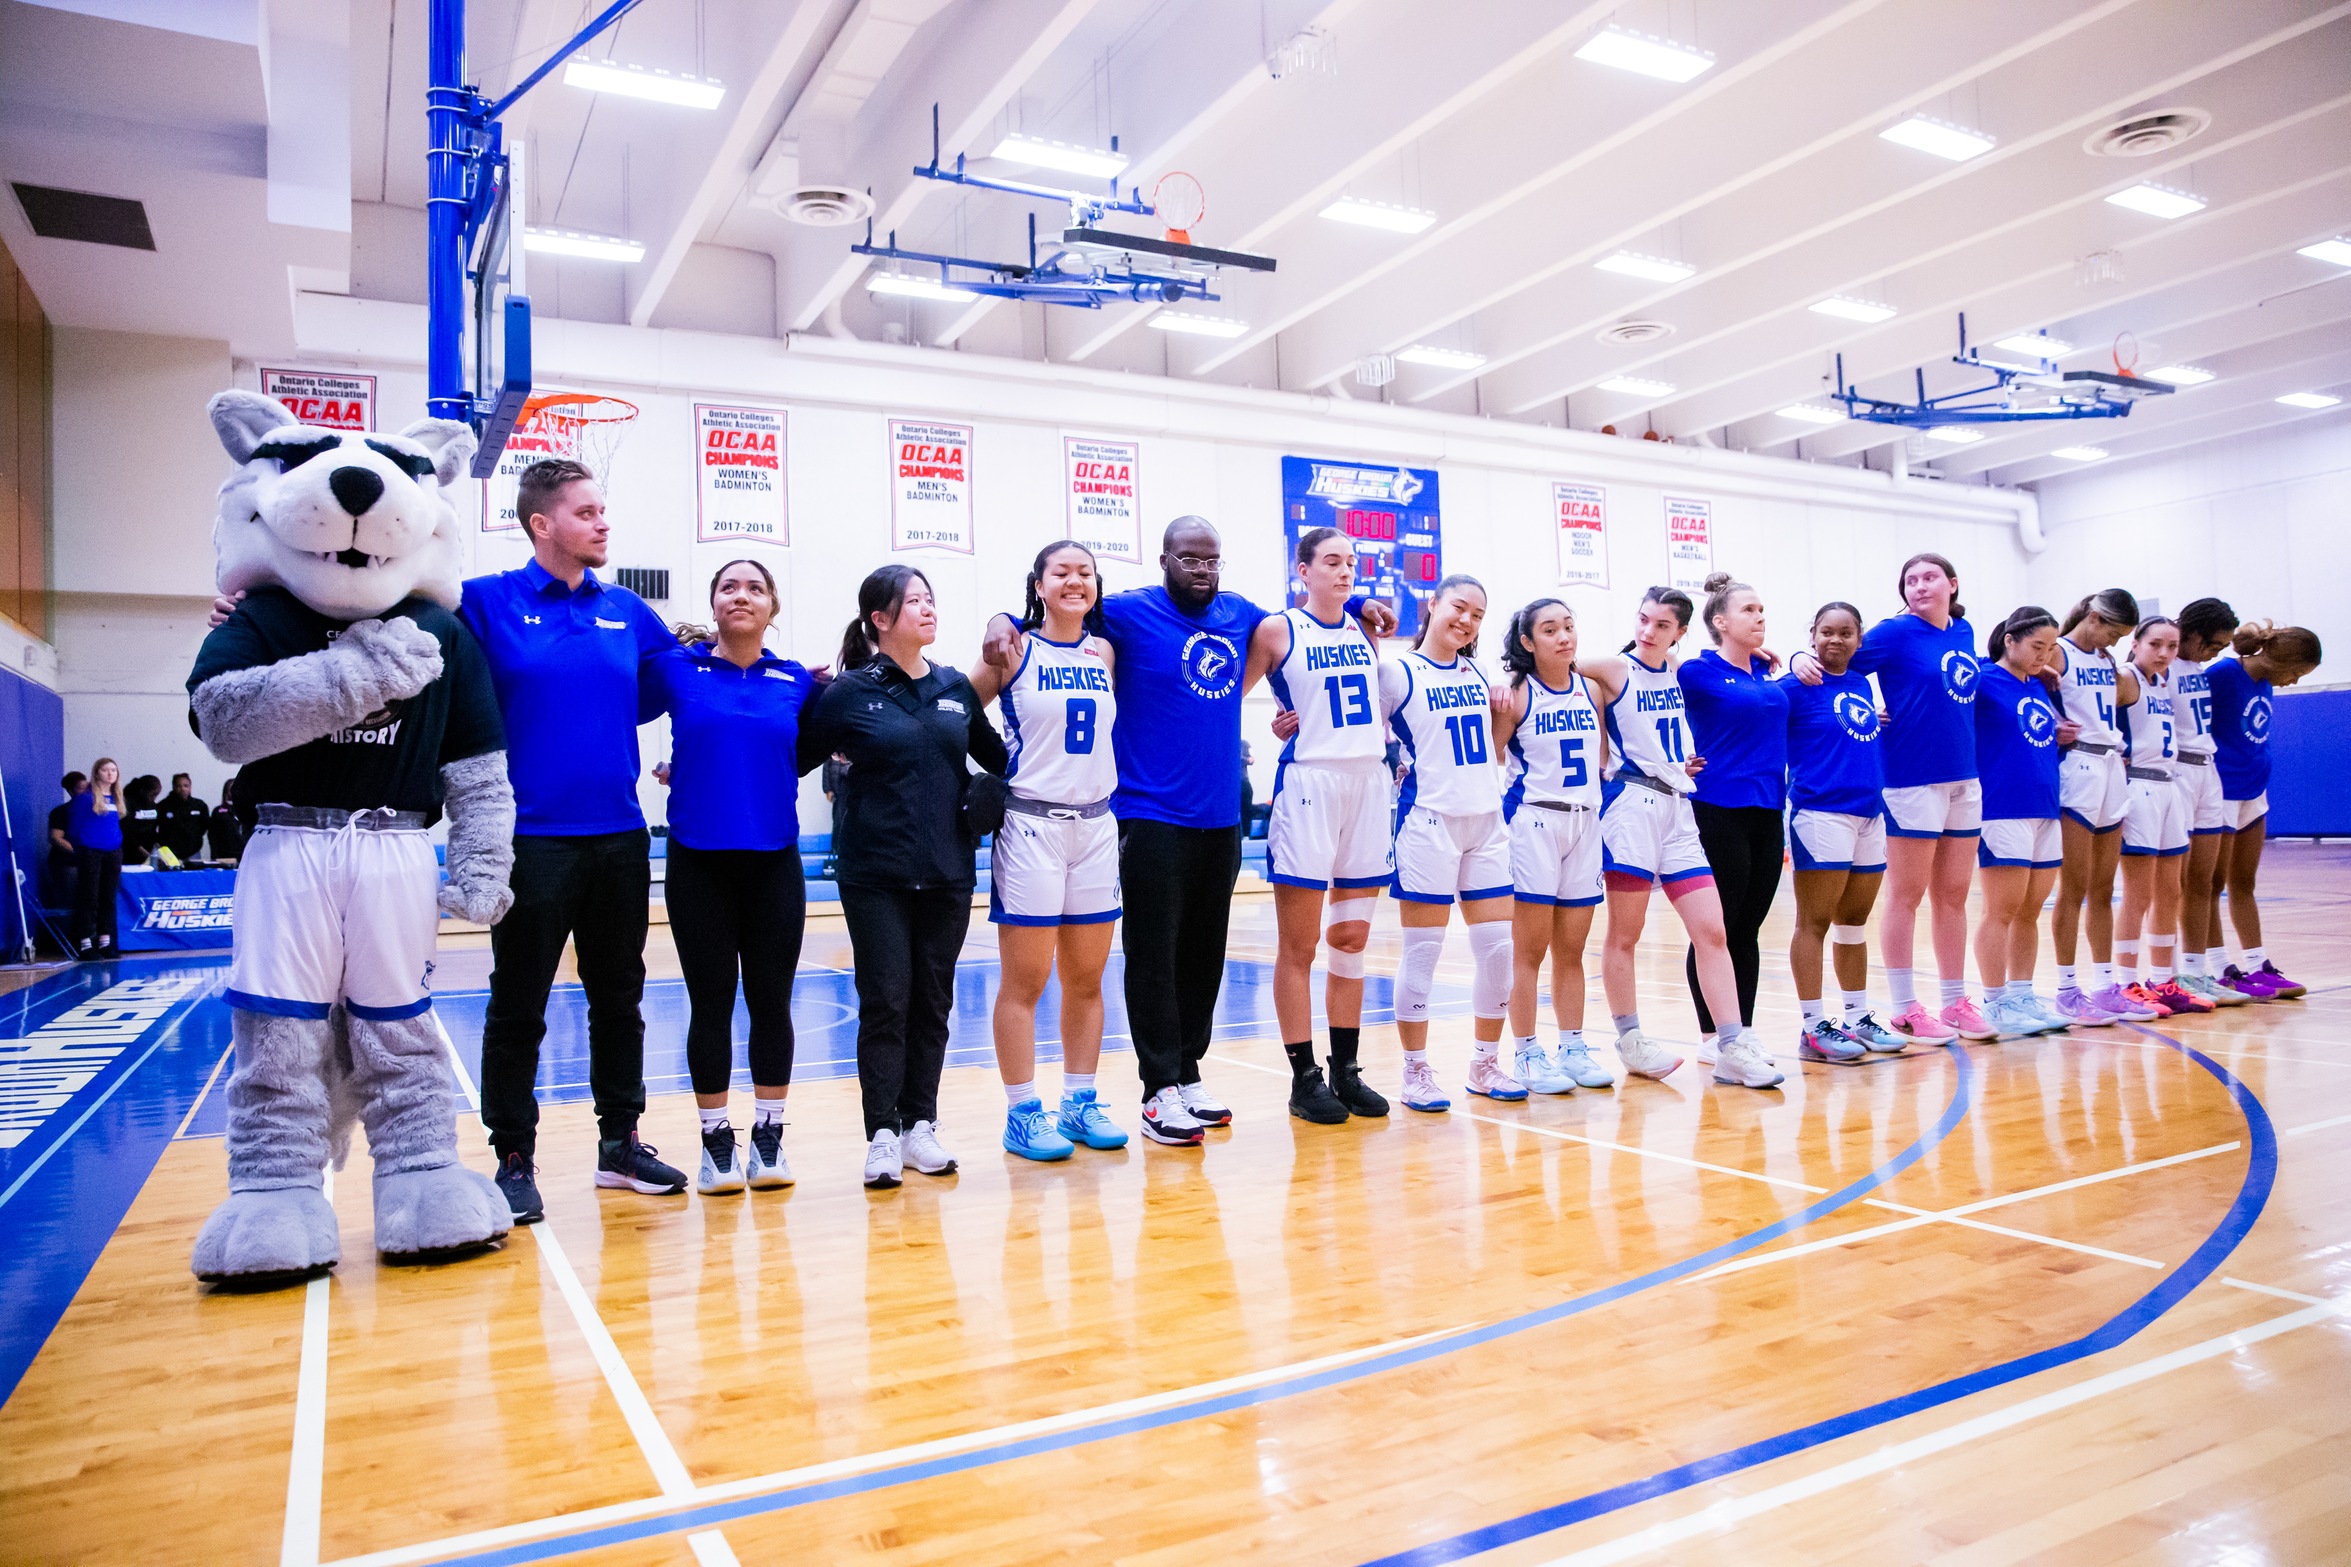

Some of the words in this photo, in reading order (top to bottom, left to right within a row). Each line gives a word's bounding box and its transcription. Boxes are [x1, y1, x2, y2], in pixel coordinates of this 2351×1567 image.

[271, 384, 309, 396] Athletic
[312, 387, 368, 399] Association
[279, 375, 316, 387] Ontario
[318, 379, 360, 390] Colleges
[702, 418, 732, 428] Athletic
[735, 420, 780, 431] Association
[708, 410, 738, 420] Ontario
[740, 412, 774, 422] Colleges
[896, 433, 923, 441] Athletic
[925, 435, 967, 446] Association
[901, 424, 928, 434] Ontario
[930, 427, 960, 437] Colleges
[708, 429, 776, 452] OCAA
[705, 451, 779, 470] CHAMPIONS
[901, 444, 962, 465] OCAA
[718, 468, 768, 481] WOMEN'S
[899, 464, 964, 482] CHAMPIONS
[1075, 462, 1129, 481] OCAA
[714, 479, 772, 491] BADMINTON
[917, 481, 948, 492] MEN'S
[1073, 480, 1133, 498] CHAMPIONS
[1314, 476, 1390, 498] HUSKIES
[906, 490, 958, 503] BADMINTON
[1082, 496, 1125, 508] WOMEN'S
[1077, 506, 1130, 517] BADMINTON
[1561, 501, 1600, 519] OCAA
[713, 520, 773, 533] 2017-2018
[1346, 509, 1395, 540] 10:00
[1671, 516, 1706, 531] OCAA
[906, 530, 959, 542] 2017-2018
[1421, 553, 1436, 581] 0
[1306, 643, 1372, 671] HUSKIES
[1037, 664, 1110, 693] HUSKIES
[2076, 667, 2116, 687] HUSKIE
[1190, 678, 1236, 700] HUSKIES
[1425, 684, 1487, 712] HUSKIES
[1324, 673, 1373, 729] 13
[2095, 692, 2114, 731] 4
[1064, 698, 1097, 755] 8
[1535, 709, 1596, 736] HUSKIES
[1444, 713, 1488, 767] 10
[1655, 716, 1685, 763] 11
[2161, 721, 2174, 759] 2
[1559, 738, 1588, 788] 5
[151, 898, 209, 911] GEORGE
[143, 911, 233, 929] HUSKIE
